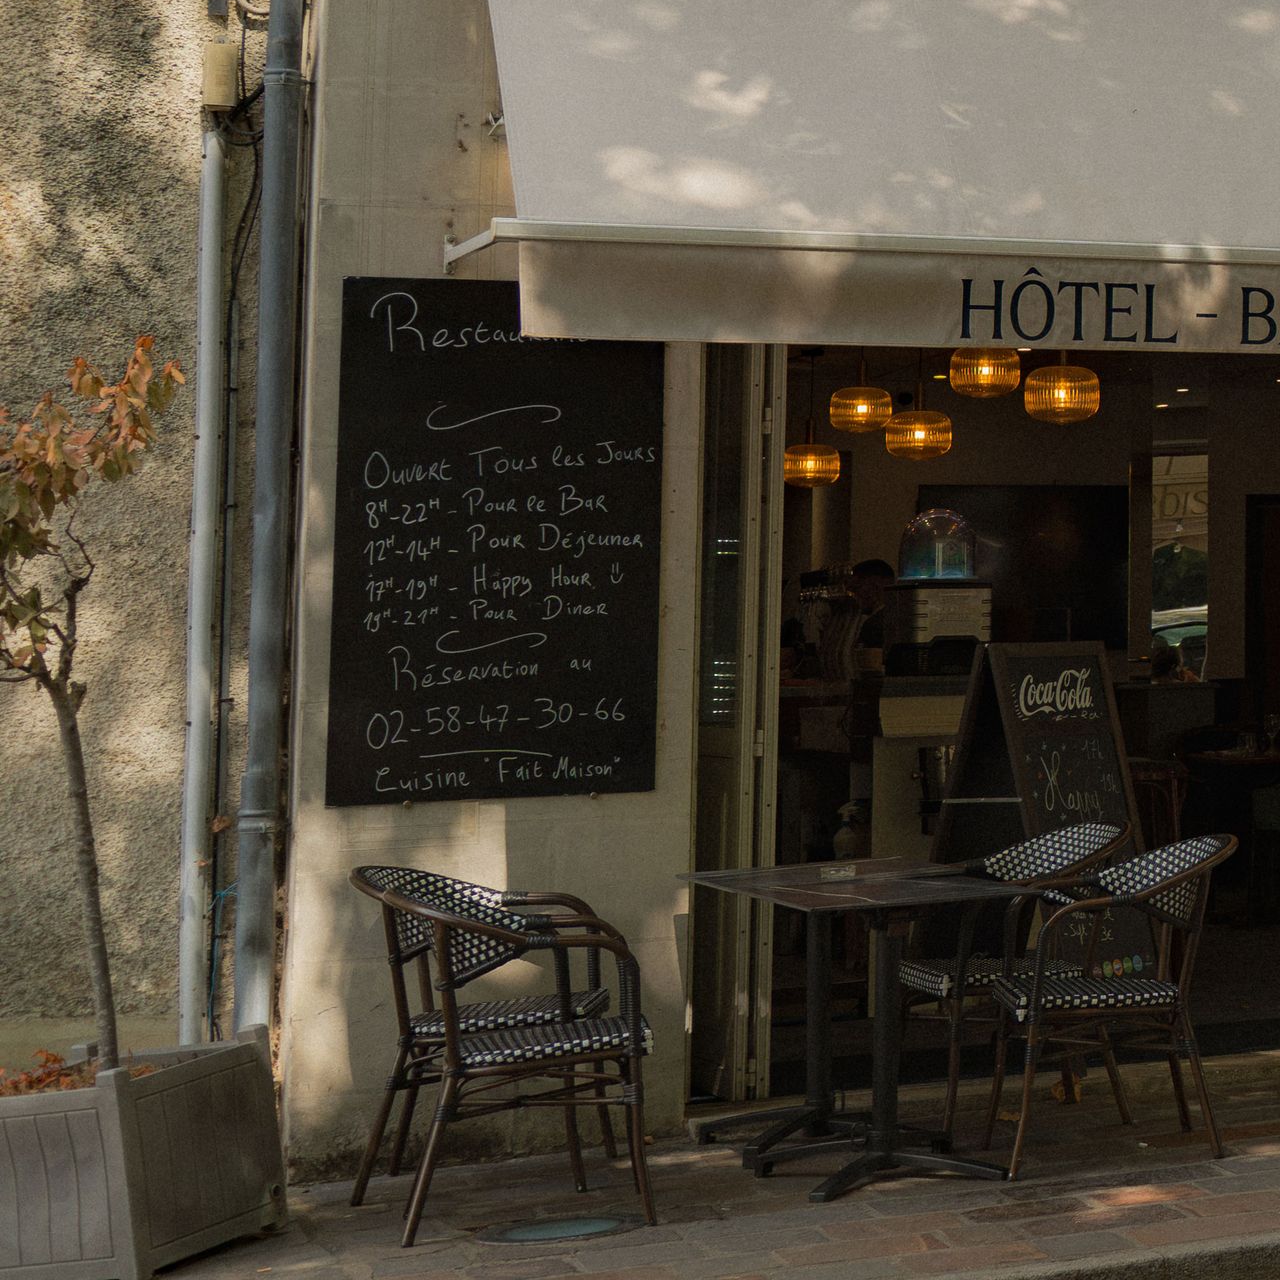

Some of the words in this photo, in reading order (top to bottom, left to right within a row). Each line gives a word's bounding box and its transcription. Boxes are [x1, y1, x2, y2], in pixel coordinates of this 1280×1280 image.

[959, 266, 1179, 344] HÔTEL
[468, 446, 538, 476] Tous
[552, 445, 585, 467] les
[527, 495, 547, 513] le
[558, 484, 609, 517] Bar
[537, 523, 644, 559] Déjeuner
[472, 563, 533, 599] Happy
[387, 645, 539, 692] Réservation
[569, 657, 592, 672] au
[1019, 668, 1094, 717] Coca-Cola
[366, 697, 627, 751] 02-58-47-30-66
[374, 766, 471, 793] Cuisine
